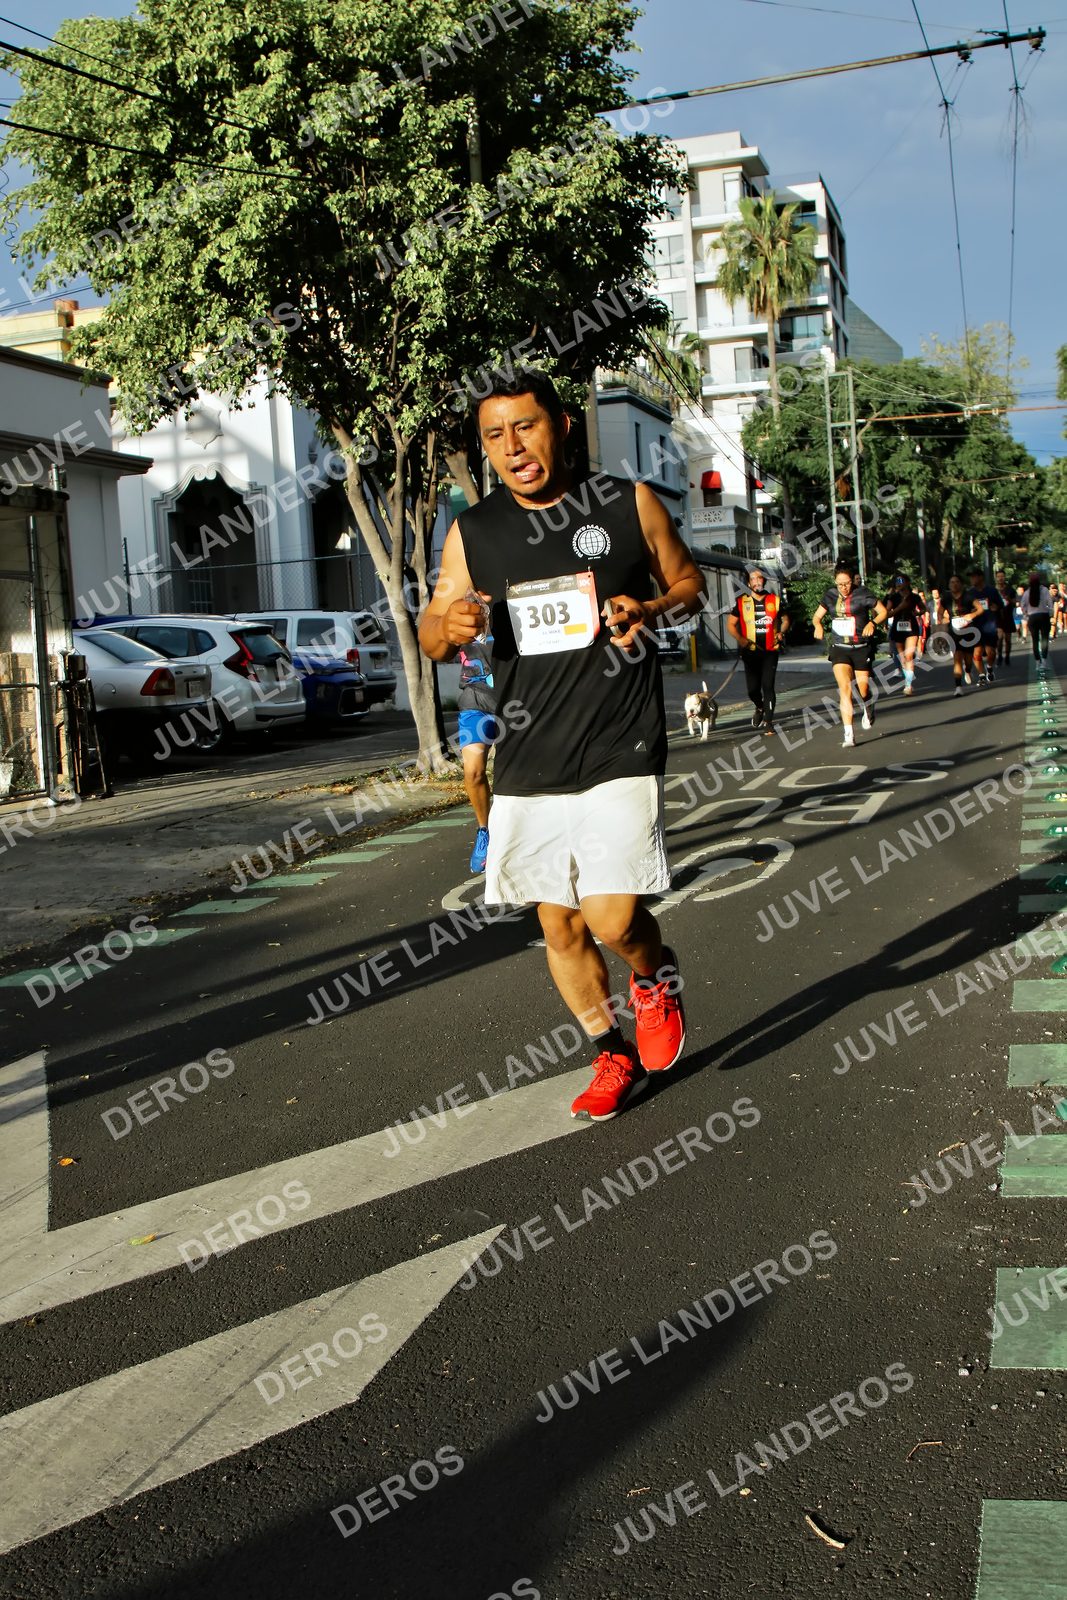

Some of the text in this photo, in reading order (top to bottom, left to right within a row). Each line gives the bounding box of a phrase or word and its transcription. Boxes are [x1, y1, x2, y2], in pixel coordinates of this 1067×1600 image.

[526, 602, 571, 629] 303
[664, 760, 954, 792] SOL
[664, 791, 894, 830] BU
